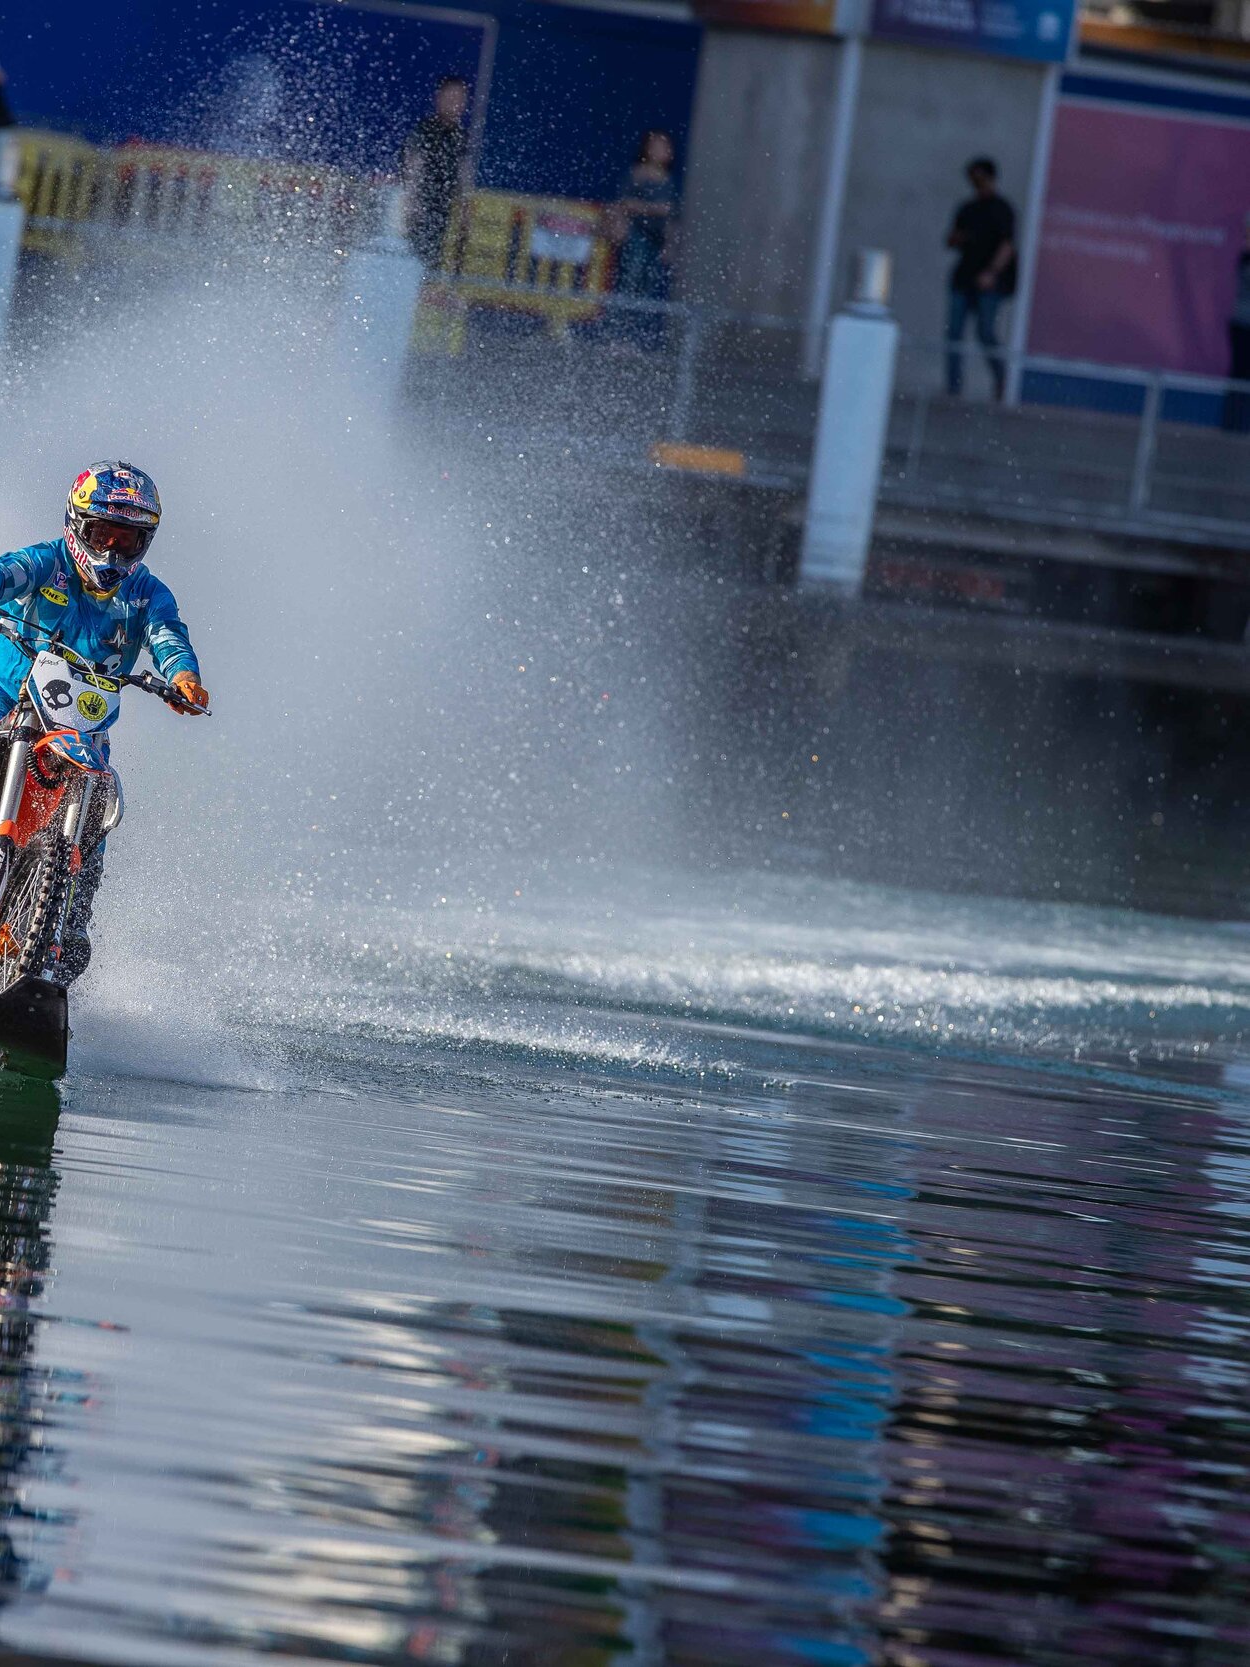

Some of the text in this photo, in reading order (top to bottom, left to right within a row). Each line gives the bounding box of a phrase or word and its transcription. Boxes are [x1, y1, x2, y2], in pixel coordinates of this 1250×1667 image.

[107, 494, 133, 502] Red
[107, 504, 141, 518] Red Bull
[67, 532, 88, 567] Bull
[41, 588, 68, 604] LINE-X
